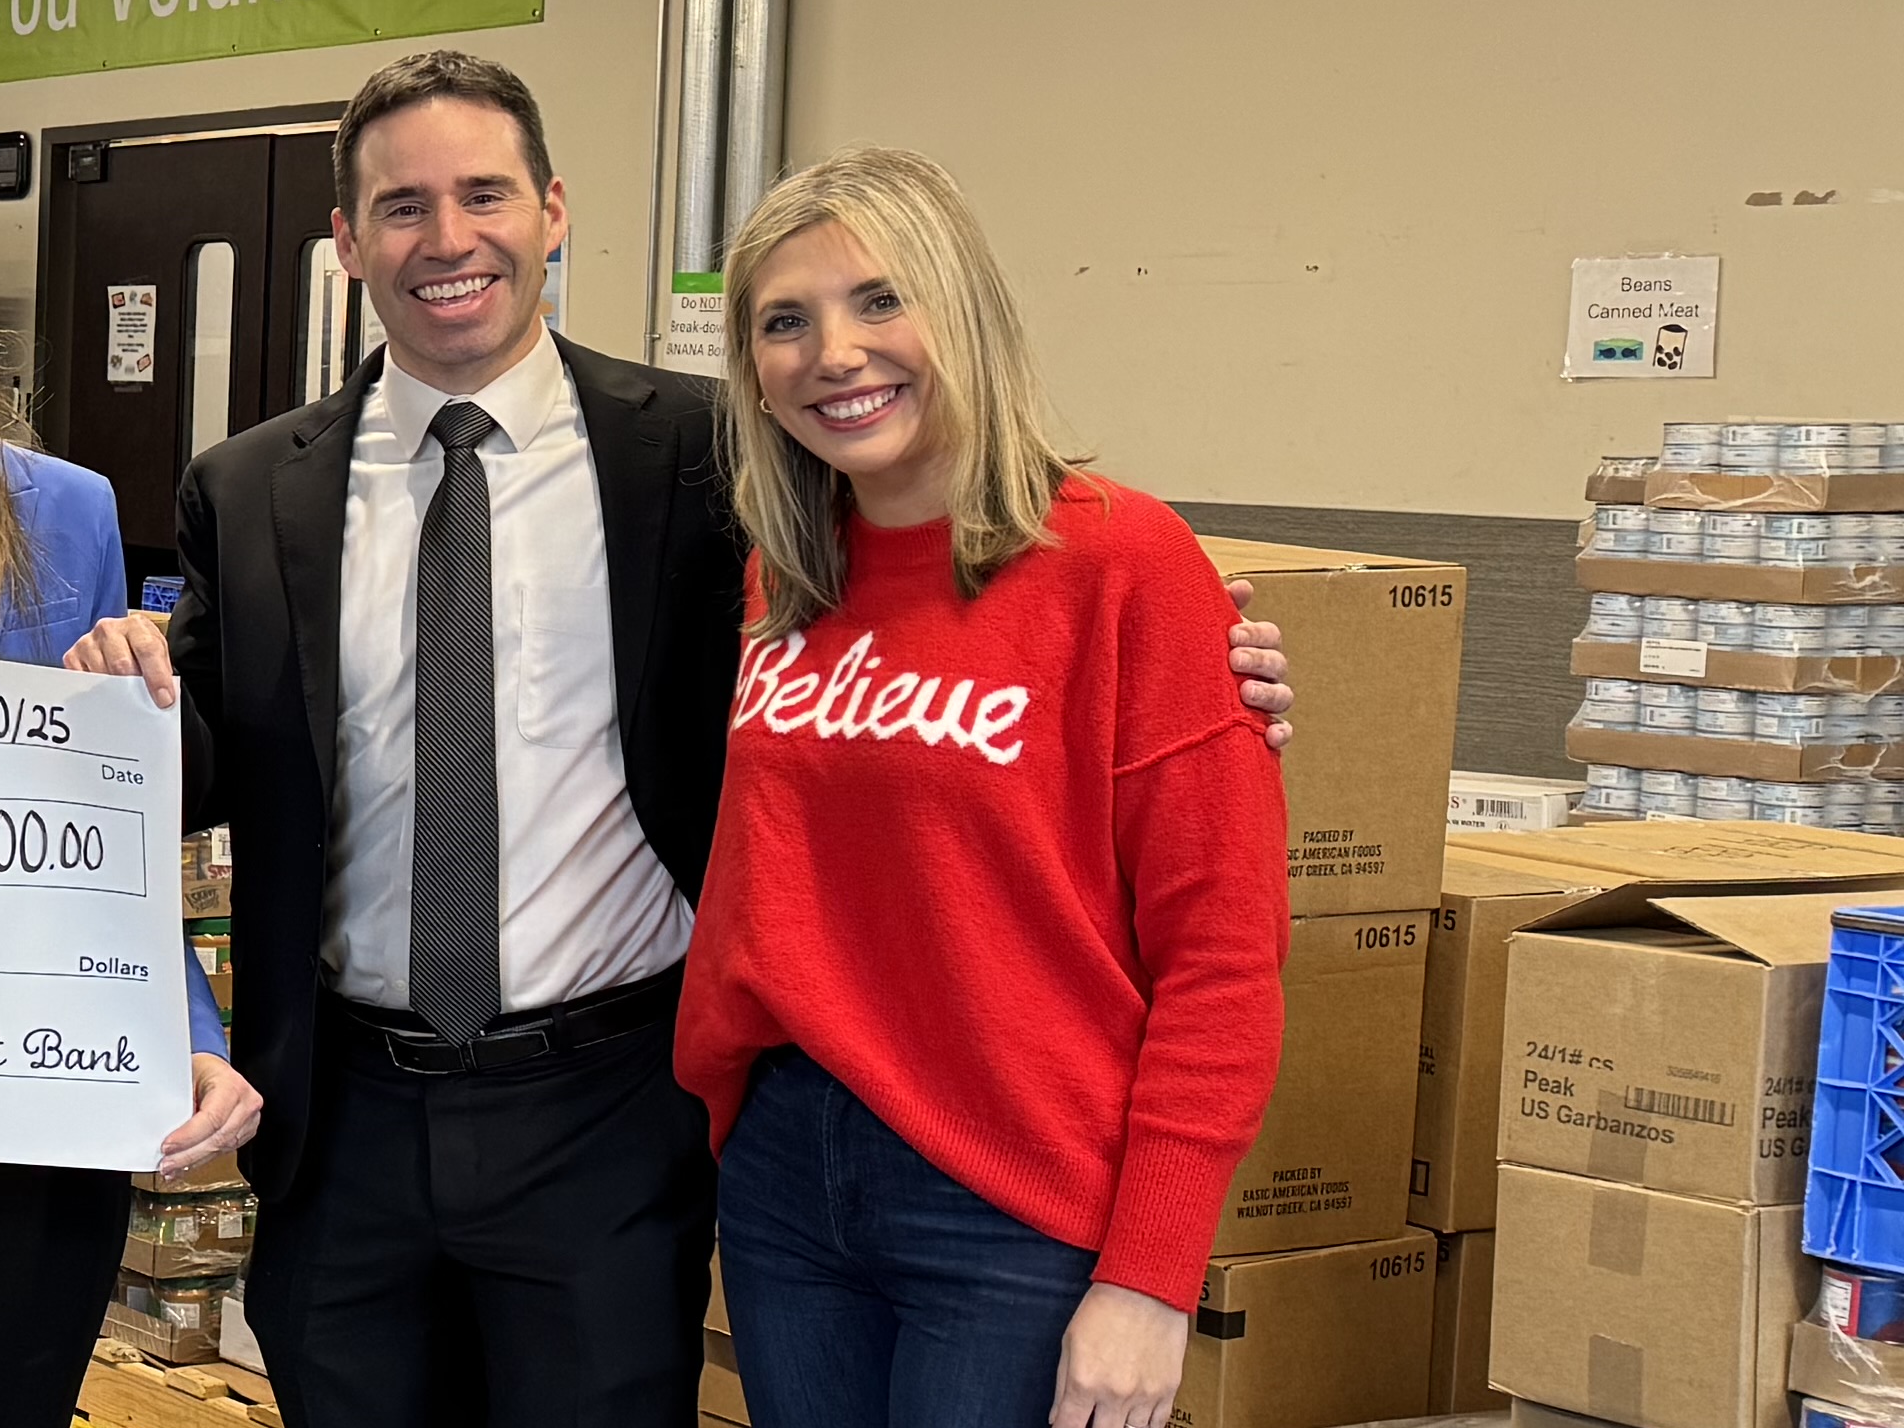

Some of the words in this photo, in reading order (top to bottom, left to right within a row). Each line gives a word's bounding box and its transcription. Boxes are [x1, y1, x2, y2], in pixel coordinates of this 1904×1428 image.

[1620, 276, 1672, 294] Beans
[681, 296, 697, 309] Do
[699, 296, 722, 310] NOT
[1587, 302, 1653, 321] Canned
[1657, 302, 1700, 320] Meat
[1388, 584, 1453, 608] 10615
[732, 627, 1031, 765] Believe
[101, 763, 145, 785] Date
[1303, 830, 1340, 843] PACKED
[1342, 829, 1354, 842] BY
[1302, 846, 1351, 860] AMERICAN
[1352, 844, 1383, 858] FOODS
[1341, 863, 1353, 875] CA
[1354, 861, 1385, 875] 94597
[1354, 923, 1417, 951] 10615
[78, 955, 149, 978] Dollars
[21, 1027, 142, 1077] Bank
[1525, 1040, 1583, 1065] 24/1#
[1523, 1069, 1575, 1098] Peak
[1520, 1095, 1550, 1121] US
[1556, 1103, 1675, 1145] Garbanzos
[1761, 1107, 1811, 1129] Peak
[1759, 1138, 1785, 1159] US
[1273, 1168, 1309, 1183] PACKED
[1309, 1167, 1322, 1180] BY
[1242, 1187, 1271, 1202] BASIC
[1272, 1183, 1319, 1201] AMERICAN
[1320, 1181, 1350, 1196] FOODS
[1237, 1203, 1274, 1219] WALNUT
[1309, 1198, 1322, 1213] CA
[1369, 1251, 1426, 1281] 10615
